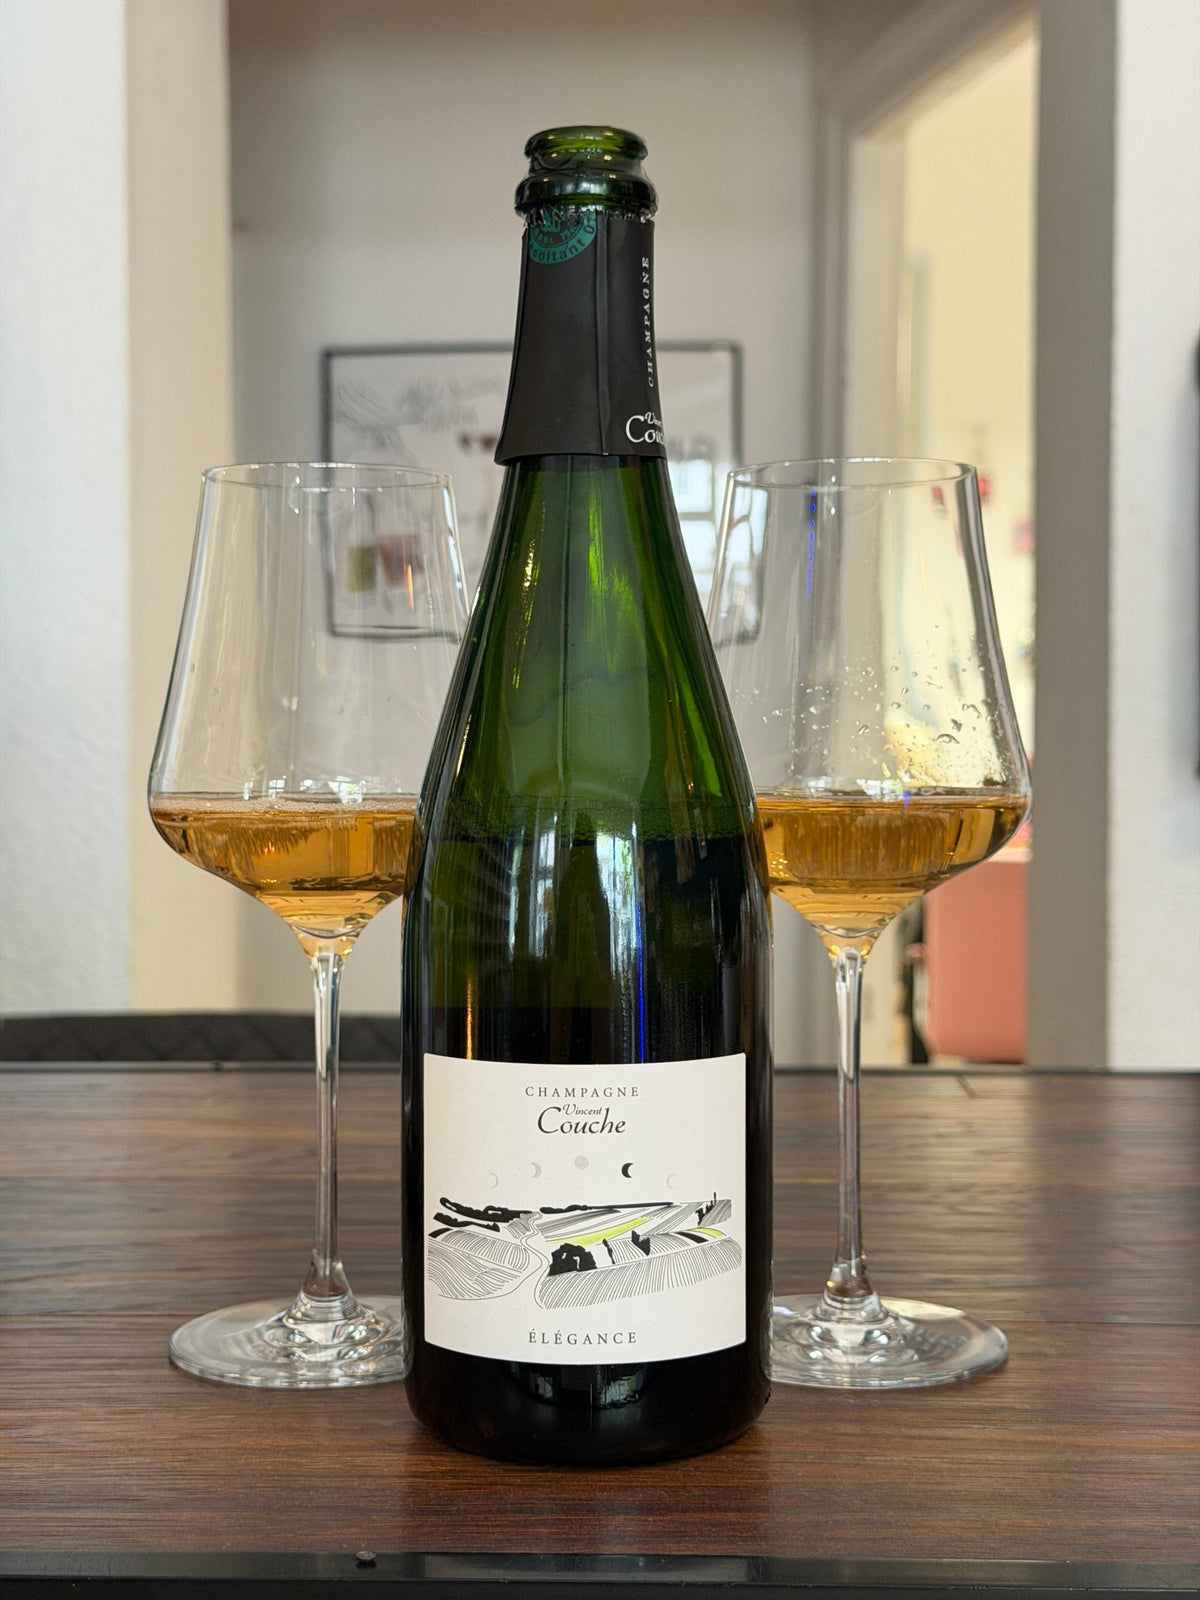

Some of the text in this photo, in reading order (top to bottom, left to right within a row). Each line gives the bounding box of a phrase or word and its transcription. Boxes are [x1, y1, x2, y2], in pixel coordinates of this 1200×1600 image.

[641, 257, 654, 387] CHAMPAGNE
[525, 1086, 639, 1098] CHAMPAGNE
[562, 1103, 602, 1115] Vincent
[537, 1106, 626, 1134] Couche
[528, 1328, 637, 1345] ÉLÉGANCE
